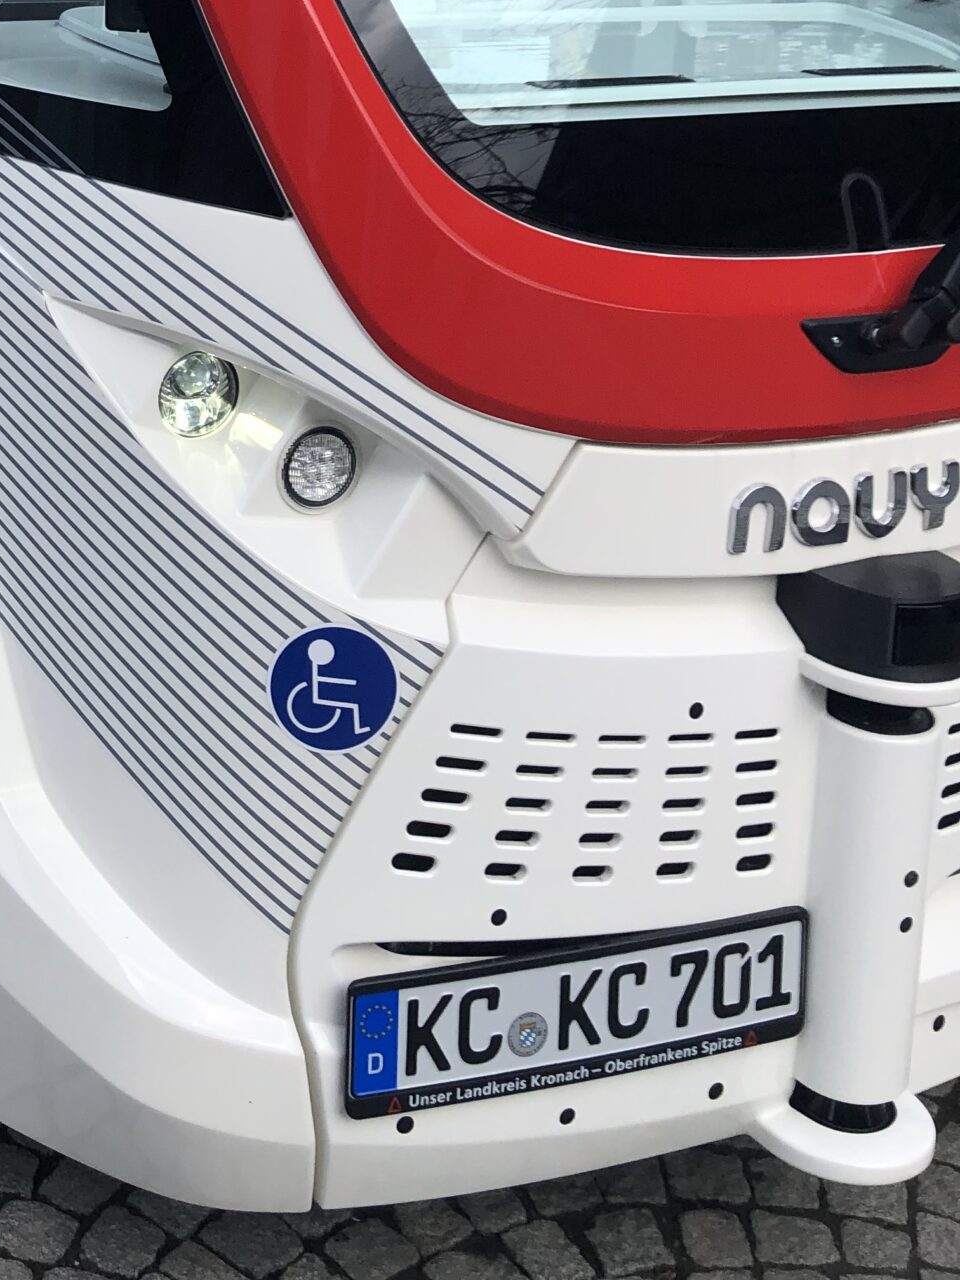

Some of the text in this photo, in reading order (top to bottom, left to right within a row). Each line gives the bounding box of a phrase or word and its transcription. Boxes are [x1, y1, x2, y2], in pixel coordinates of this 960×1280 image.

[405, 985, 504, 1077] KC
[558, 960, 650, 1051] KC
[670, 933, 793, 1028] 701
[367, 1052, 384, 1075] D
[408, 1091, 453, 1108] Unser
[456, 1077, 527, 1100] Landkreis
[530, 1065, 589, 1088] Kronach
[604, 1046, 698, 1074] Oberfrankens
[701, 1036, 743, 1055] Spitze
